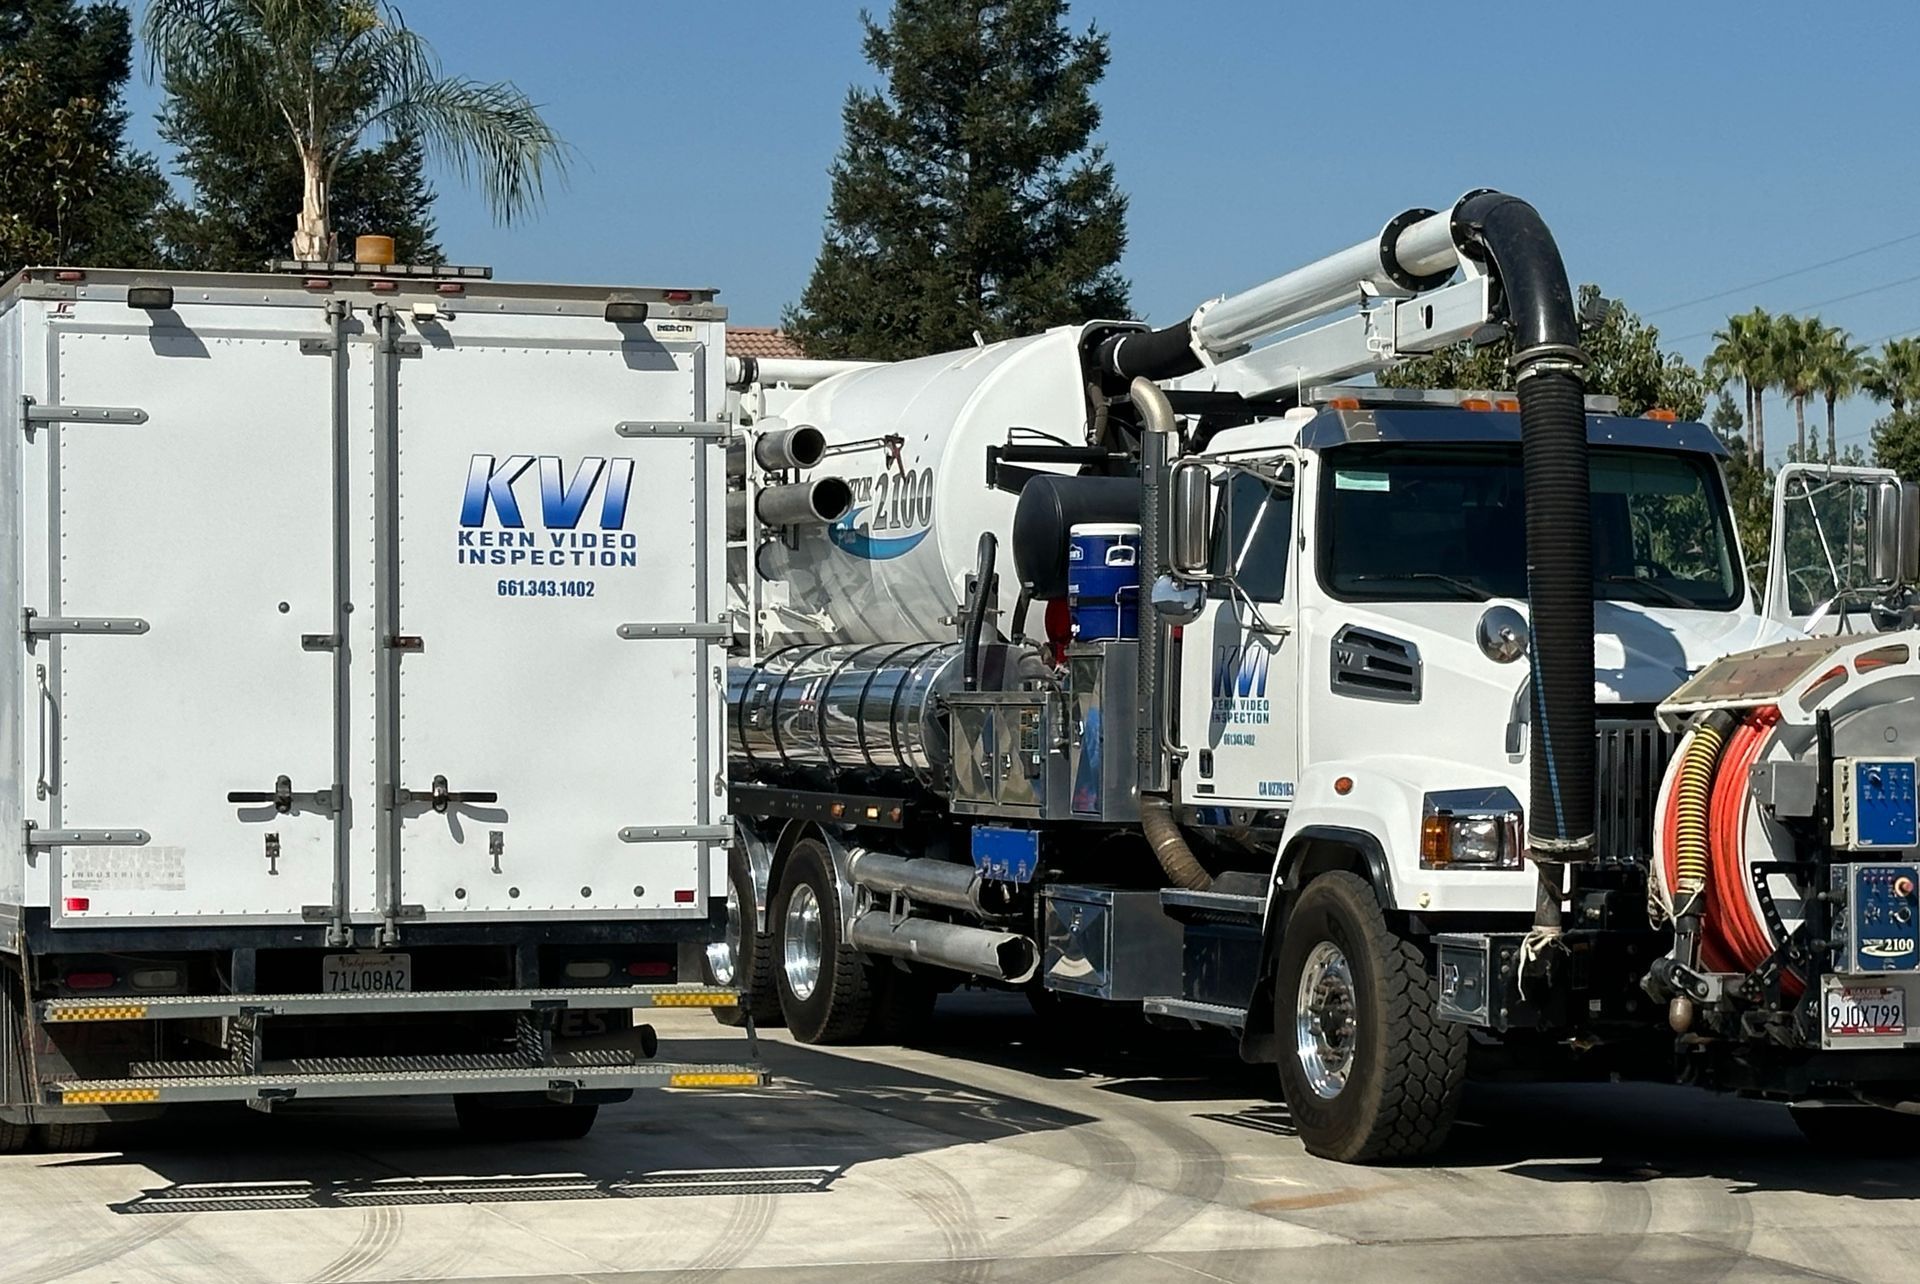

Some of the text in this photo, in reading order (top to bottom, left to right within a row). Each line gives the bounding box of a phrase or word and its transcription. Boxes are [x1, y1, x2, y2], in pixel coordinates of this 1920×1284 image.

[459, 454, 635, 530] KVI
[872, 467, 933, 530] 2100
[458, 530, 637, 549] KERN VIDEO
[458, 549, 637, 567] INSPECTION
[497, 579, 596, 598] 661.343.1402
[1212, 643, 1270, 698] KVI
[1213, 699, 1270, 712] KERN VIDEO
[1212, 712, 1270, 724] INSPECTION
[1884, 938, 1914, 952] 2100
[328, 970, 405, 992] 71408A2
